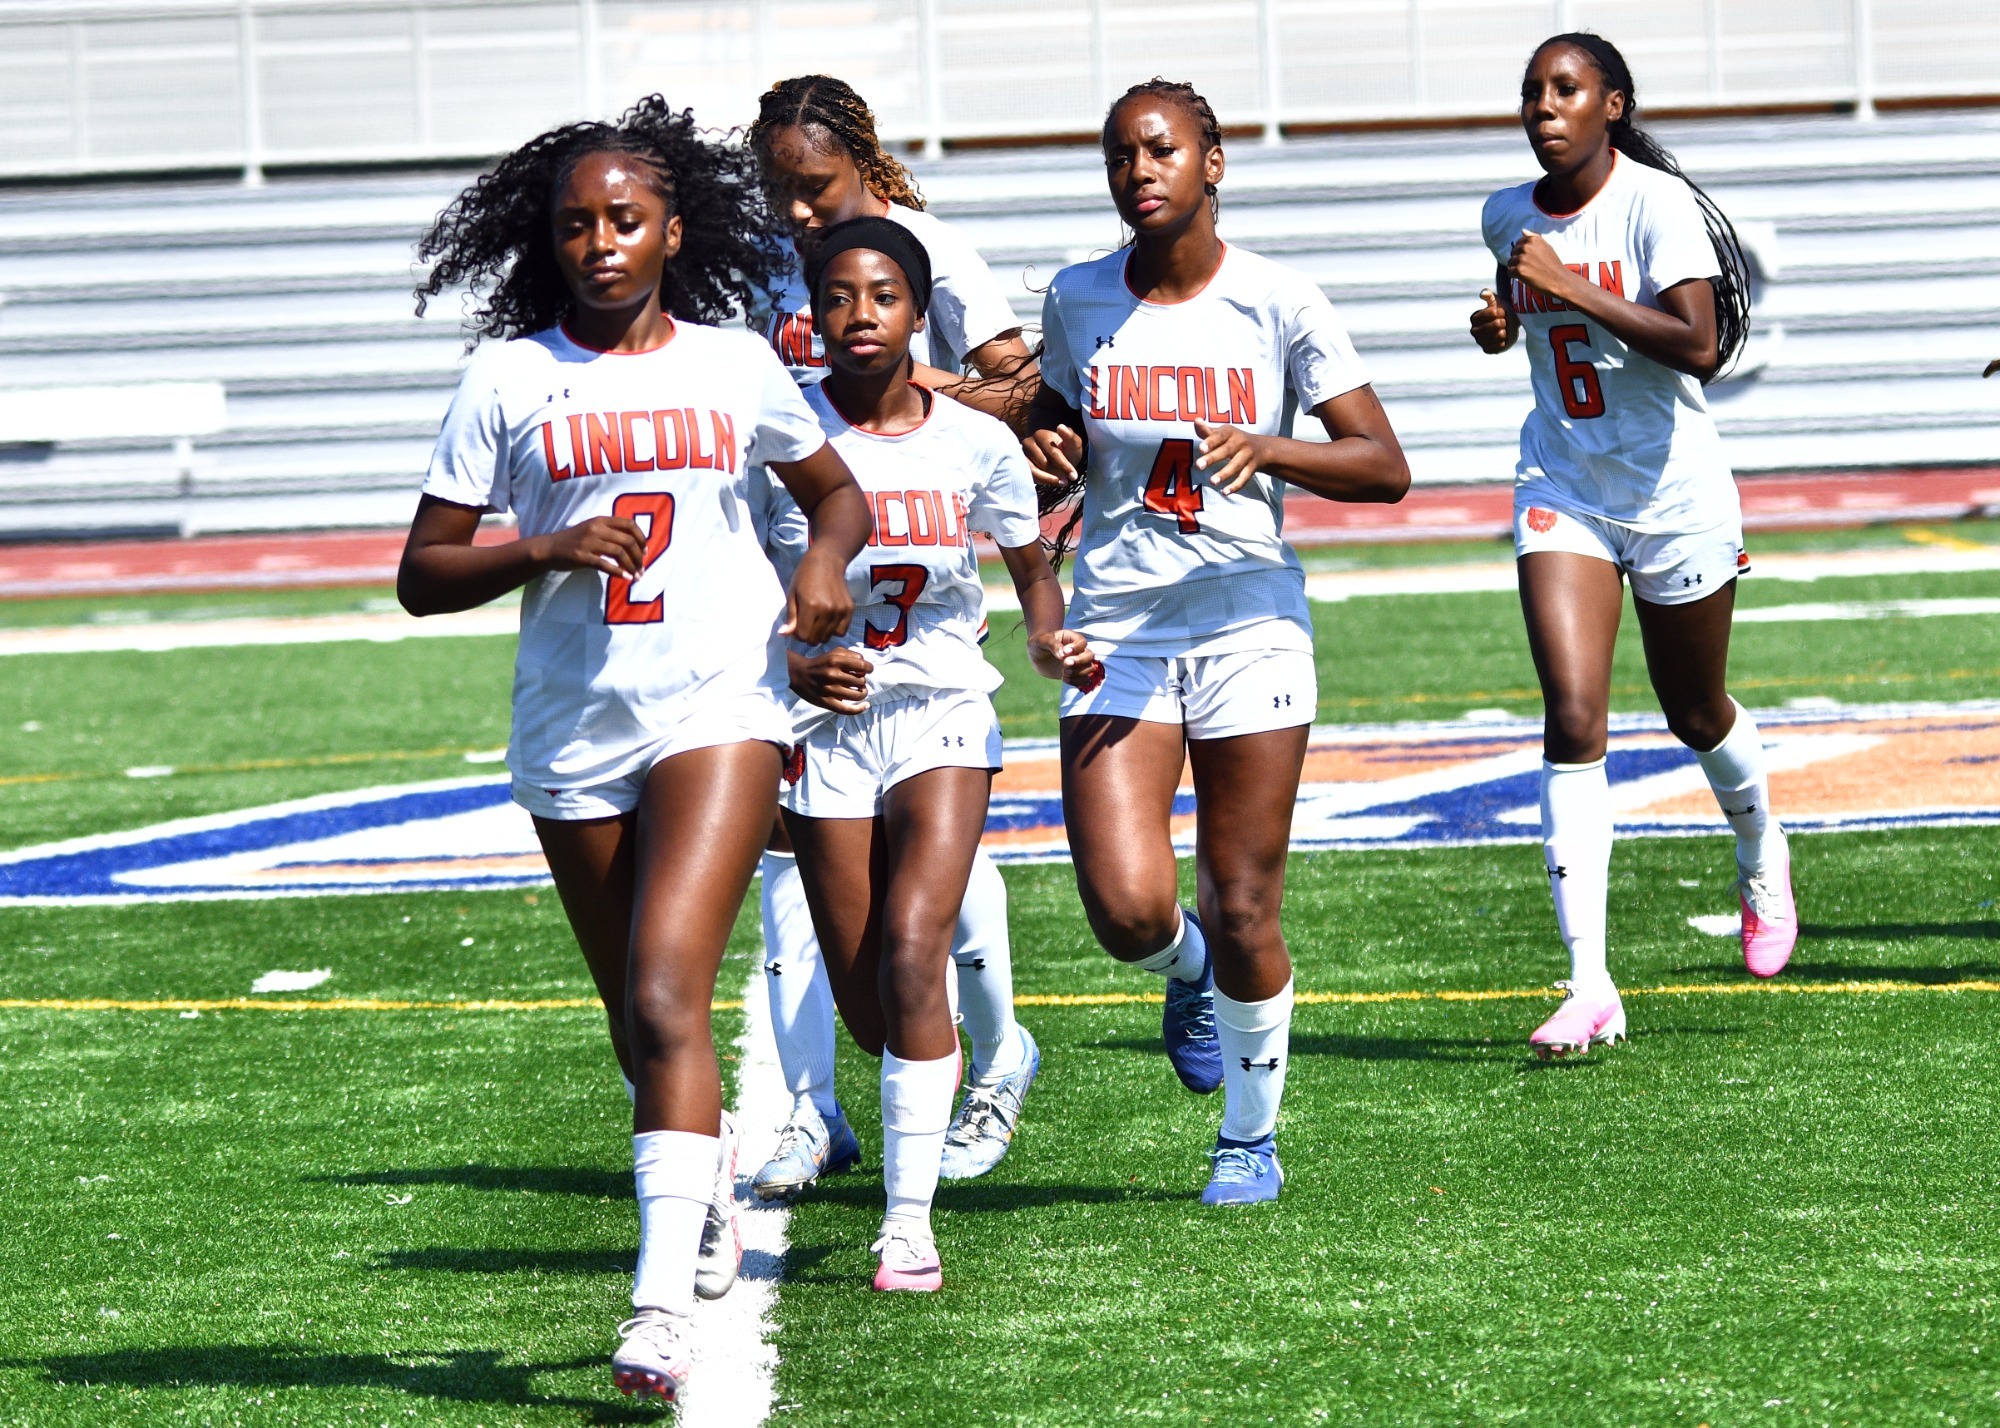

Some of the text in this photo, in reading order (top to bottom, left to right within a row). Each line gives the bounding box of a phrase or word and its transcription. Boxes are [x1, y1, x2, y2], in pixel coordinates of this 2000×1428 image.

[1089, 365, 1257, 424] LINCOLN
[1549, 323, 1605, 419] 6
[542, 408, 737, 483] LINCOLN
[1143, 438, 1205, 534] 4
[603, 492, 675, 625] 2
[864, 564, 929, 651] 3
